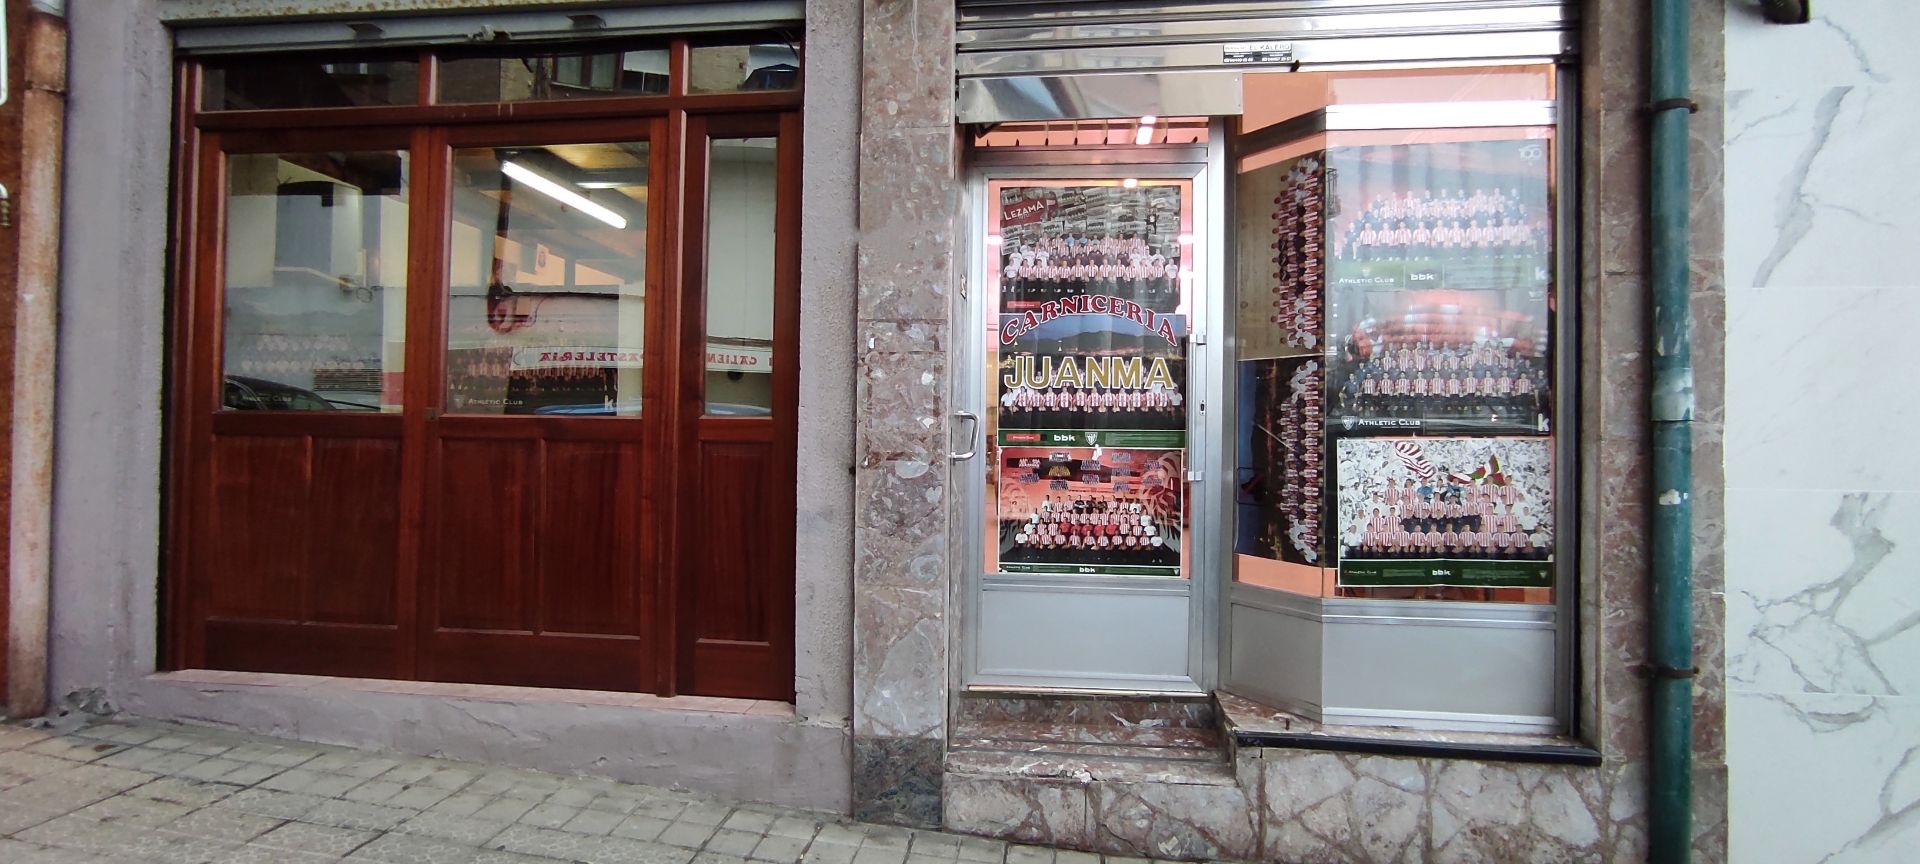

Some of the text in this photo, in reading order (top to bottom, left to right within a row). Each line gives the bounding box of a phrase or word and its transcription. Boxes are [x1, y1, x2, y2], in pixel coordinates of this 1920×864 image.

[1003, 200, 1045, 221] LEZAMA
[1410, 273, 1435, 281] bbk
[1000, 294, 1178, 347] CARNICERIA
[1004, 356, 1175, 390] JUANMA
[1398, 418, 1421, 426] CLUB
[1053, 434, 1076, 442] bbk
